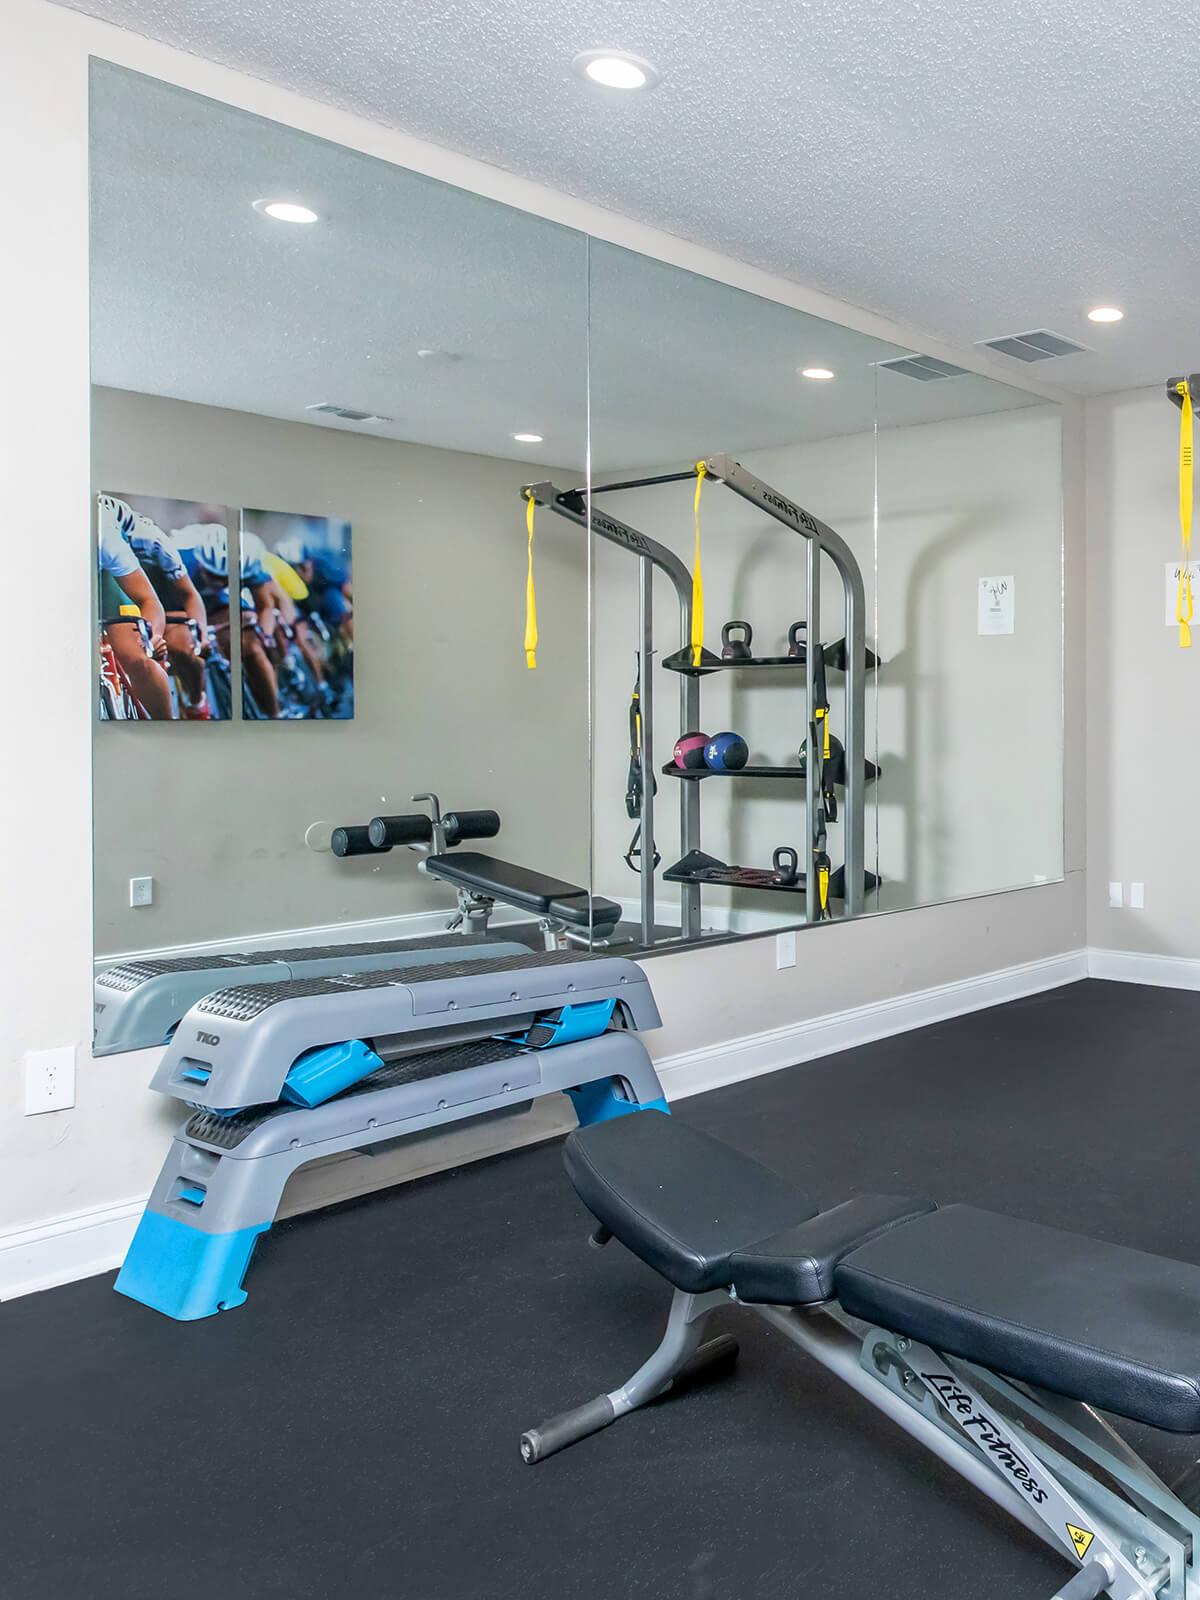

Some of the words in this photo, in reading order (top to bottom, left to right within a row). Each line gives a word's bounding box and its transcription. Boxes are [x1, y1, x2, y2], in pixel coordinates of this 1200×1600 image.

[196, 1031, 221, 1046] TKO
[921, 1372, 972, 1415] Life
[962, 1412, 1048, 1504] Fitness
